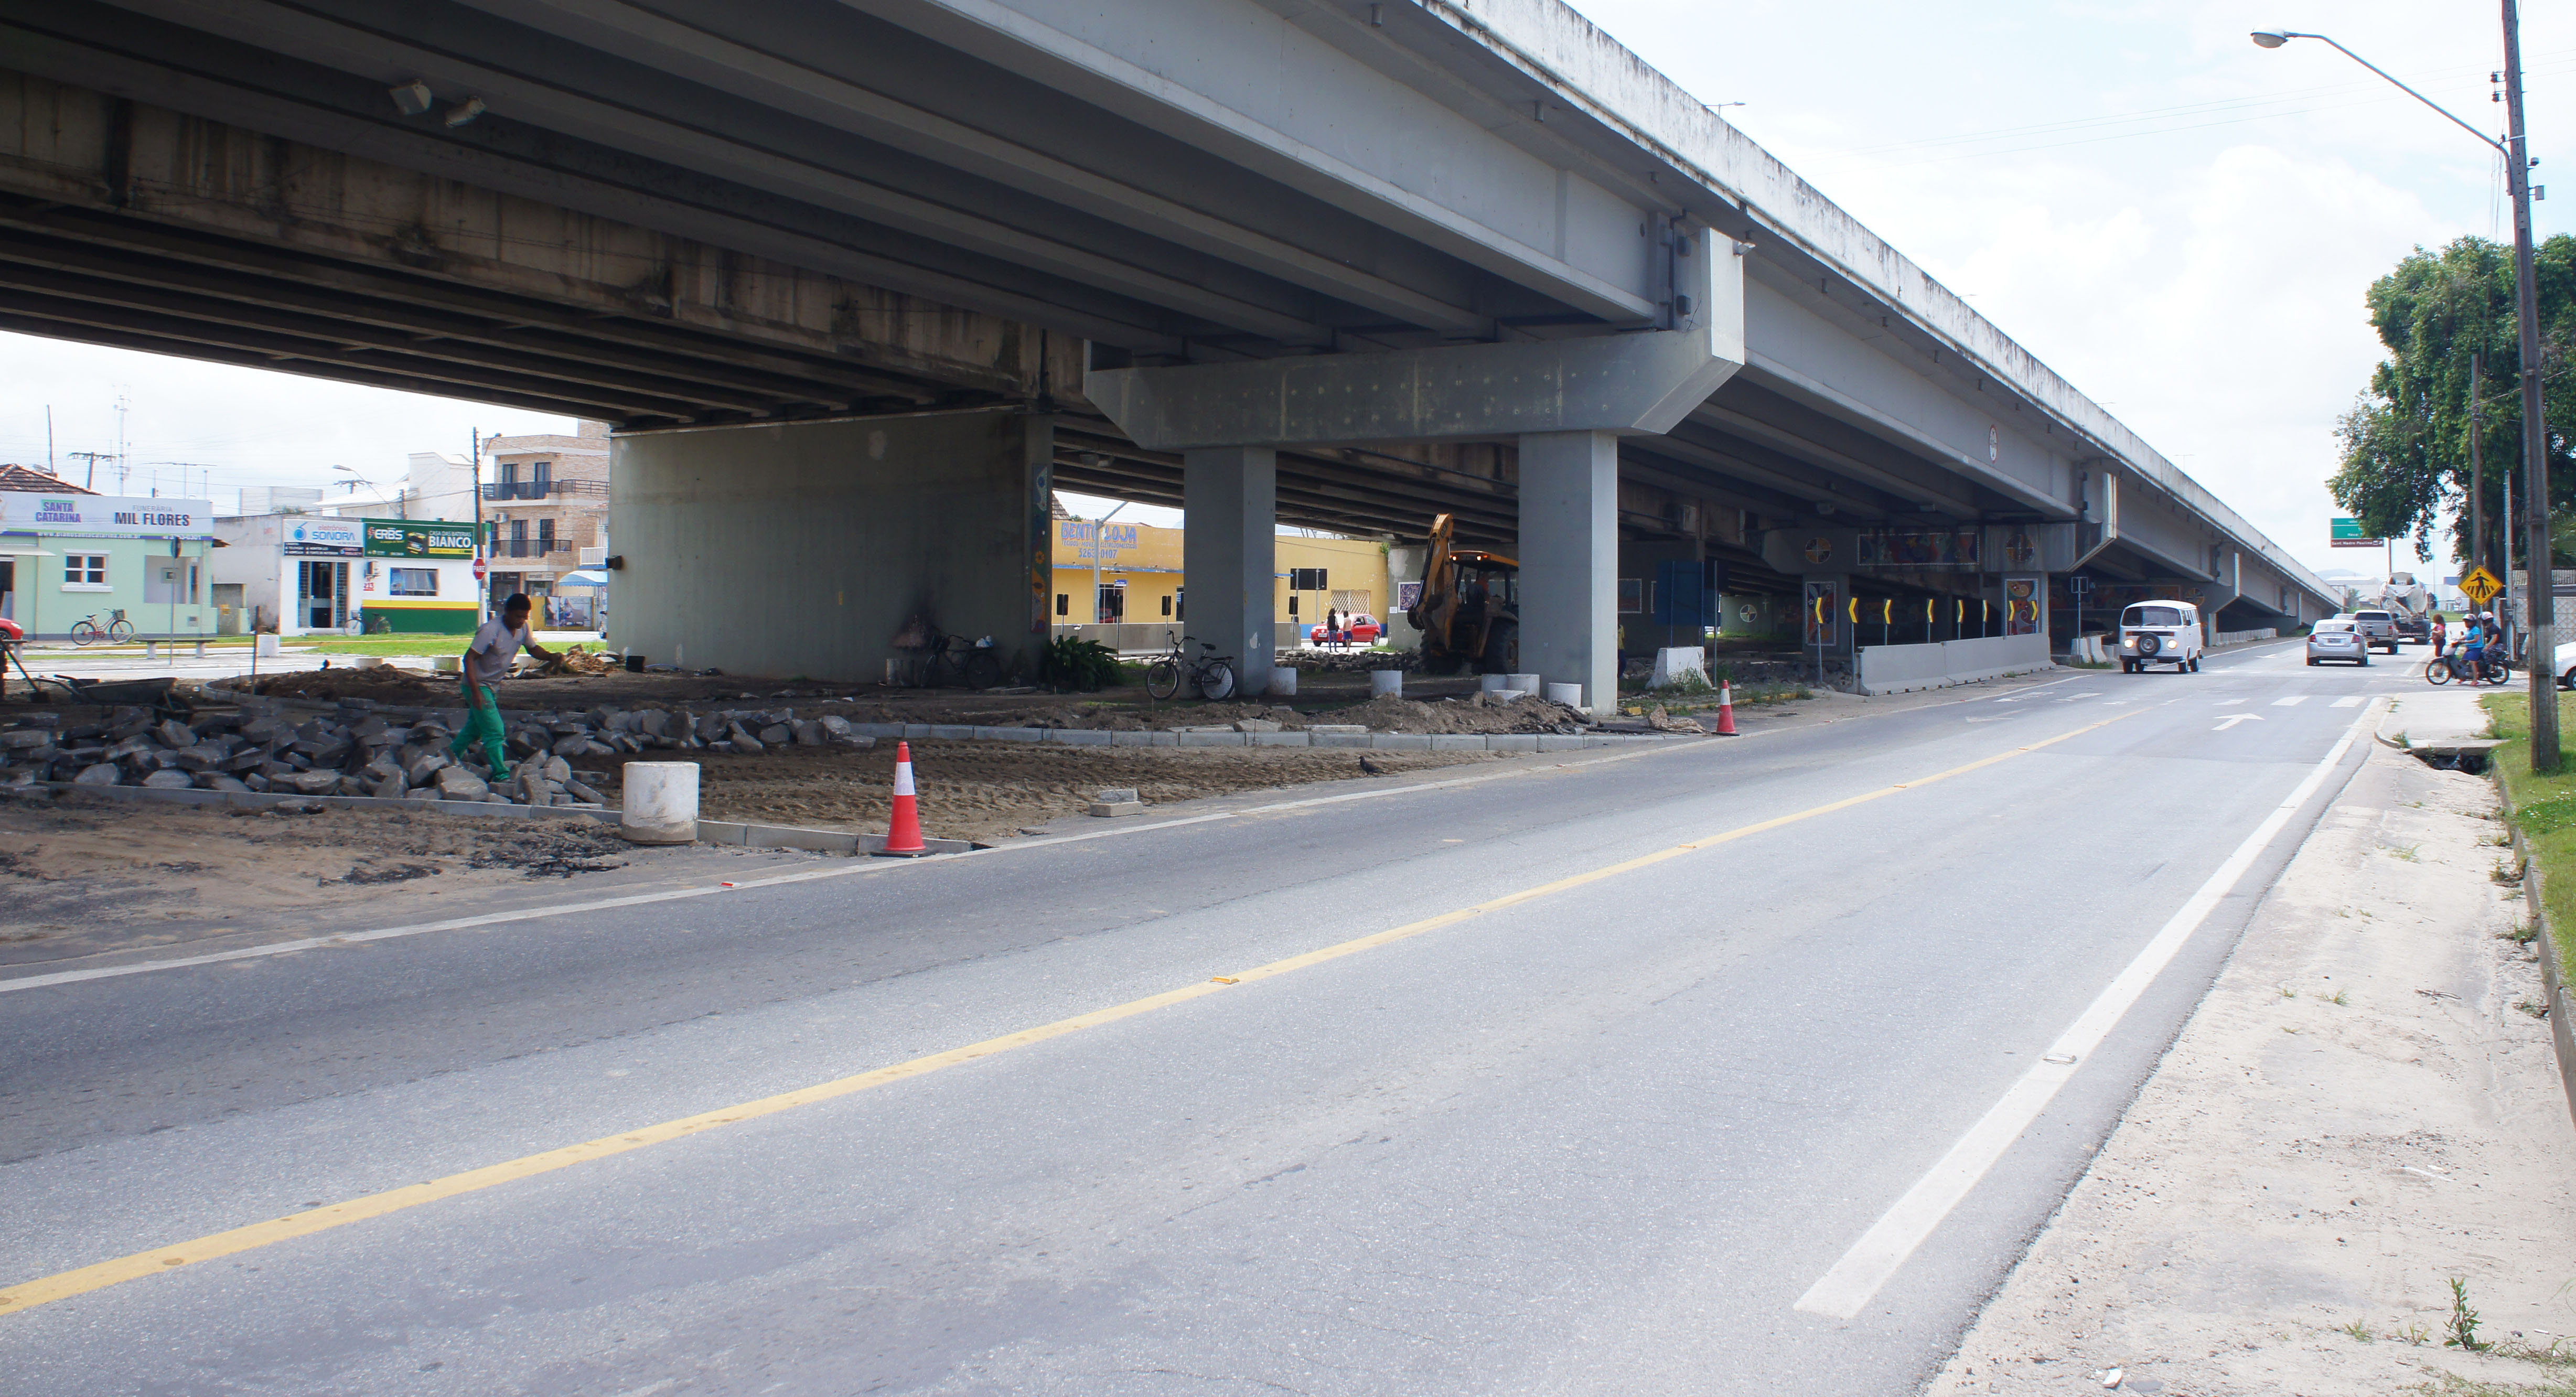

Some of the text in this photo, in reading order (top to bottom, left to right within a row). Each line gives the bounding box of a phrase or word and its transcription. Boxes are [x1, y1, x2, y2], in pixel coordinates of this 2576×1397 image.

[43, 502, 74, 512] SANTA
[36, 512, 81, 523] CATARINA
[114, 512, 190, 526] MIL FLORES
[374, 529, 404, 540] ERBS
[1104, 525, 1137, 543] LOJA
[428, 536, 471, 548] BIANCO
